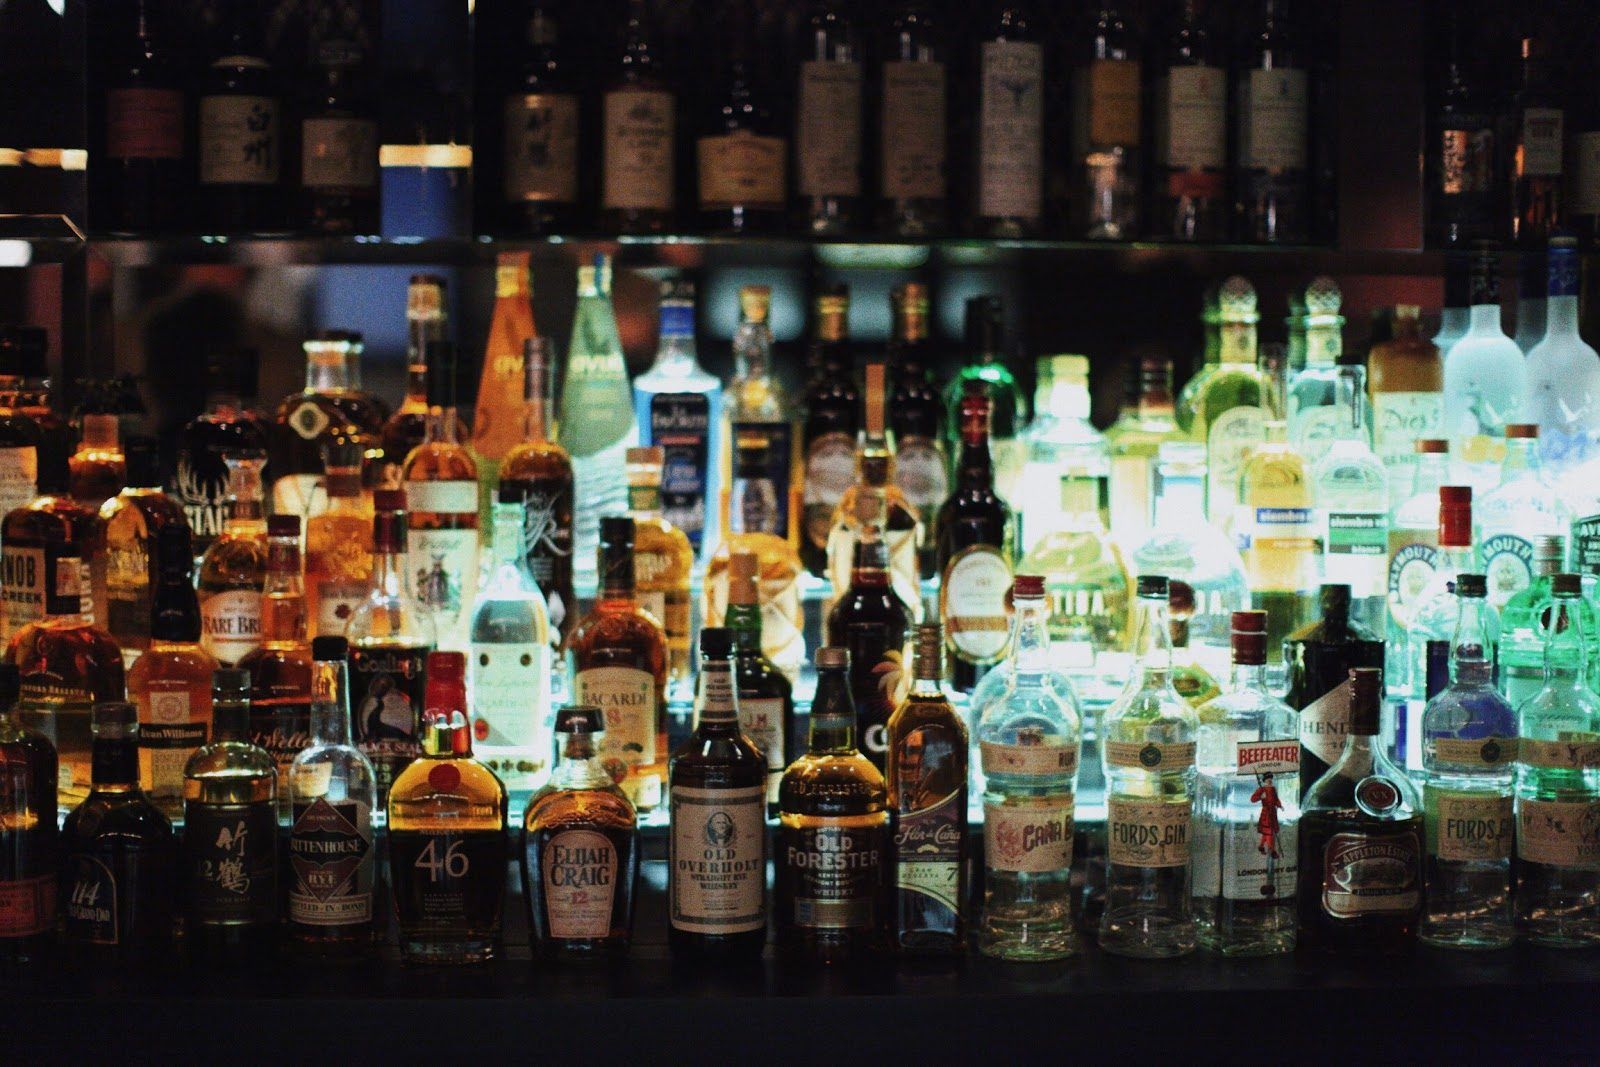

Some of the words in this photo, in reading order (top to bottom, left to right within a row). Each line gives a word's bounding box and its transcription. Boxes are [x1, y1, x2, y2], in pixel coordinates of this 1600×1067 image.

[1238, 746, 1299, 767] BEEFEATER
[1113, 822, 1158, 846] FORDS
[1160, 825, 1186, 846] GIN
[1446, 817, 1496, 840] FORDS
[815, 834, 853, 851] OLD
[414, 839, 470, 882] 46
[552, 844, 610, 865] ELIJAH
[704, 849, 736, 860] OLD
[787, 846, 880, 871] FORESTER
[551, 864, 610, 889] CRAIG
[679, 859, 760, 874] OVERHOLT
[946, 866, 958, 881] 7
[71, 880, 101, 906] 114
